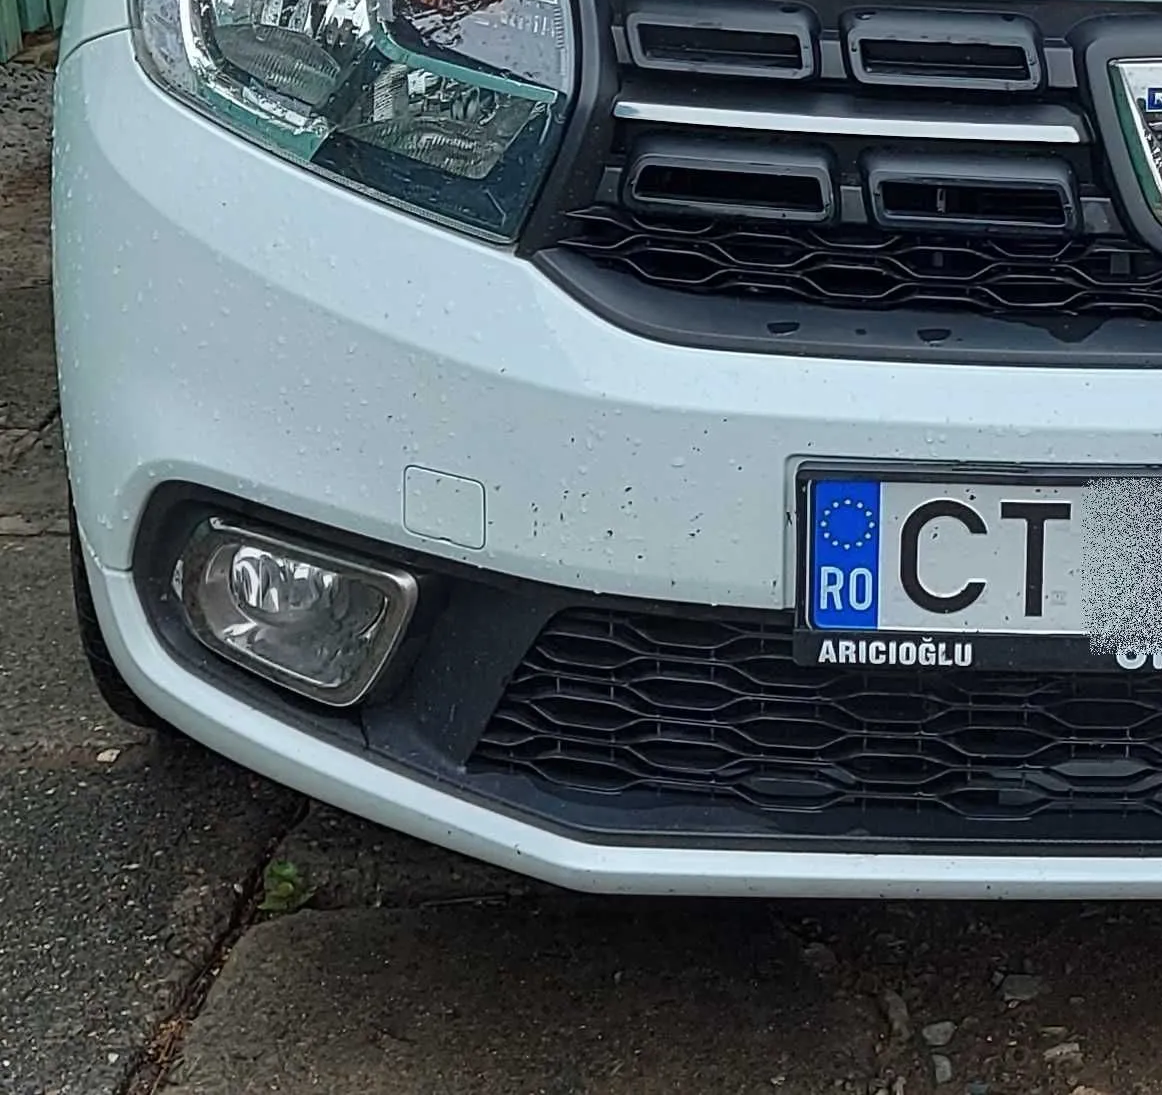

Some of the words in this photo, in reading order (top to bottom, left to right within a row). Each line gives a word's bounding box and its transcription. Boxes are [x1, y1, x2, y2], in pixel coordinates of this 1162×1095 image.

[819, 566, 874, 611] RO
[900, 498, 1072, 617] CT
[818, 637, 973, 667] ARICIOĞLU
